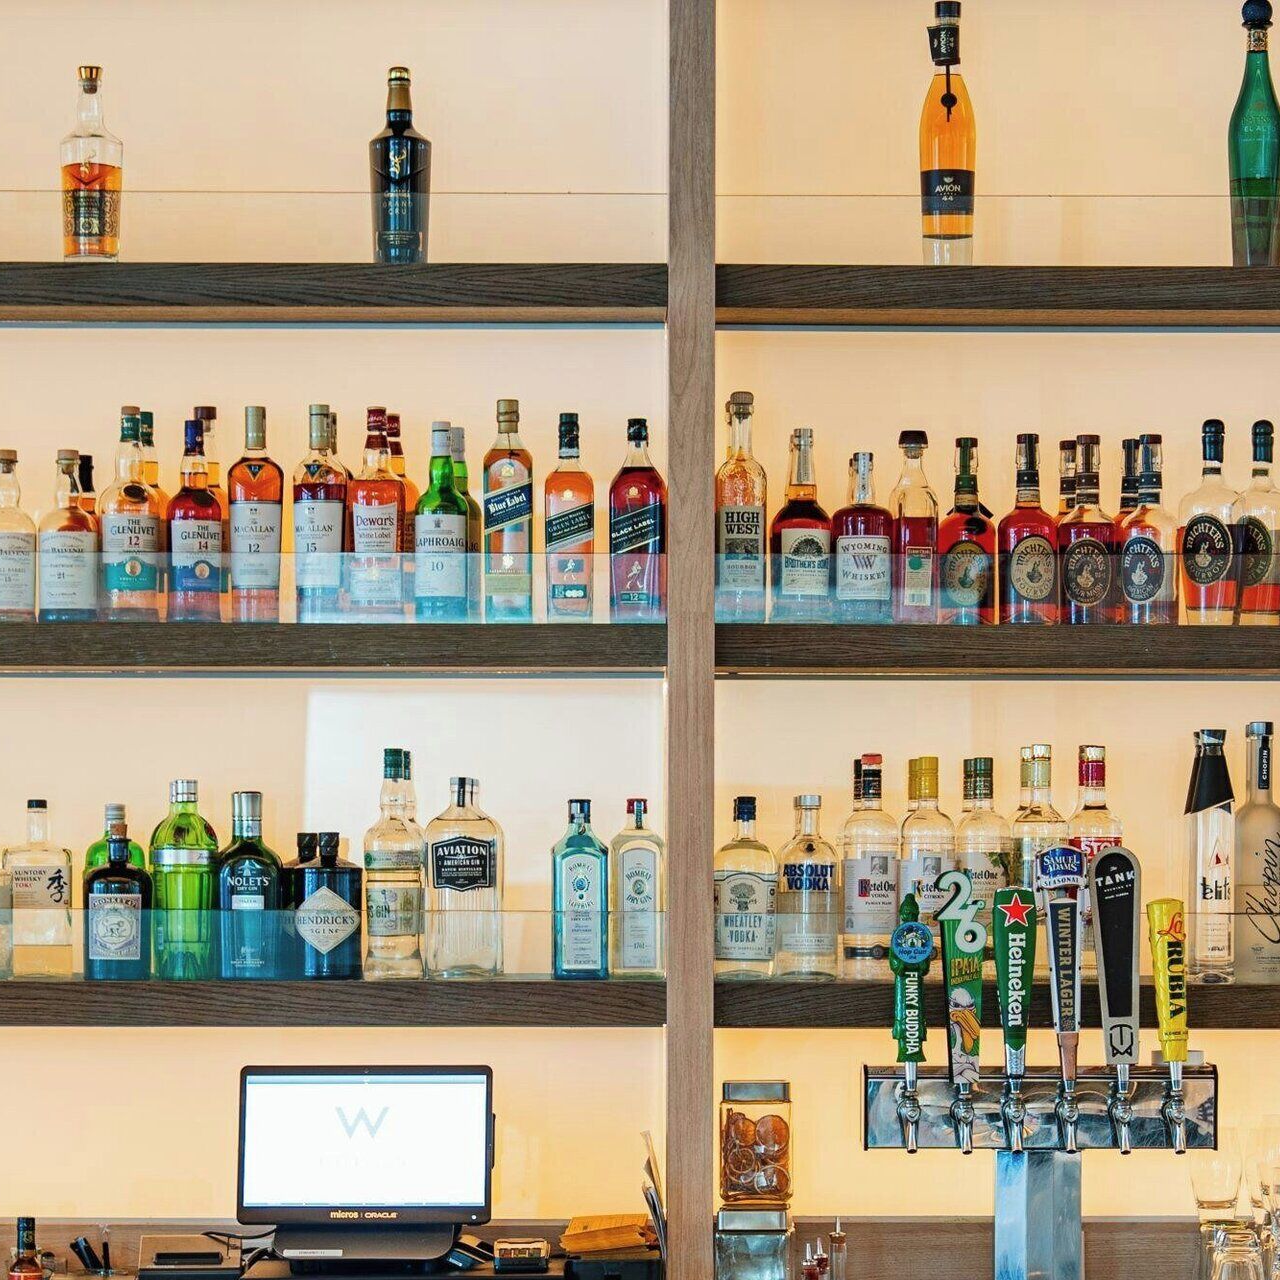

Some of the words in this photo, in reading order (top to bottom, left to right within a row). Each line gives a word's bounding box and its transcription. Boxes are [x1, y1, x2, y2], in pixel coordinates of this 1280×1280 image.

[506, 492, 527, 508] Label
[355, 515, 394, 528] Dewar's
[724, 511, 760, 523] HIGH
[233, 524, 276, 534] MACALLAN
[294, 524, 334, 534] MACALLAN
[634, 517, 656, 531] LABEL
[724, 523, 760, 535] WEST
[111, 524, 155, 537] GLENLIVET
[181, 530, 222, 542] GLENLIVET
[128, 536, 140, 546] 12
[198, 541, 209, 550] 14
[416, 537, 465, 548] LAPHROAIG
[248, 543, 261, 553] 12
[305, 543, 317, 553] 15
[840, 543, 888, 554] WYOMING
[430, 561, 444, 571] 10
[784, 556, 816, 569] BROTHER'S
[841, 570, 887, 581] WHISKEY
[437, 845, 487, 857] AVIATION
[1043, 854, 1080, 867] SAMUEL
[782, 864, 835, 877] ABSOLUT
[983, 869, 998, 879] One
[1046, 862, 1078, 874] ADAMS
[227, 876, 269, 887] NOLET'S
[786, 878, 829, 891] VODKA
[1043, 877, 1081, 887] SEASONAL
[1095, 870, 1136, 887] TANK
[47, 868, 68, 903] 季
[859, 879, 884, 897] Ketel
[884, 881, 896, 892] One
[297, 915, 356, 926] HENDRICK'S
[722, 915, 763, 929] WHEATLEY
[1058, 906, 1073, 961] WINTER
[1157, 912, 1187, 943] La
[730, 930, 757, 943] VODKA
[898, 948, 911, 957] Hop
[1007, 931, 1024, 1028] Heineken
[1166, 941, 1186, 1019] RUBIA
[904, 971, 919, 1008] FUNKY
[1058, 965, 1074, 1016] LAGER
[904, 1008, 919, 1055] BUDDHA
[334, 1106, 390, 1139] W
[329, 1210, 358, 1219] micros
[364, 1211, 397, 1219] ORACLE
